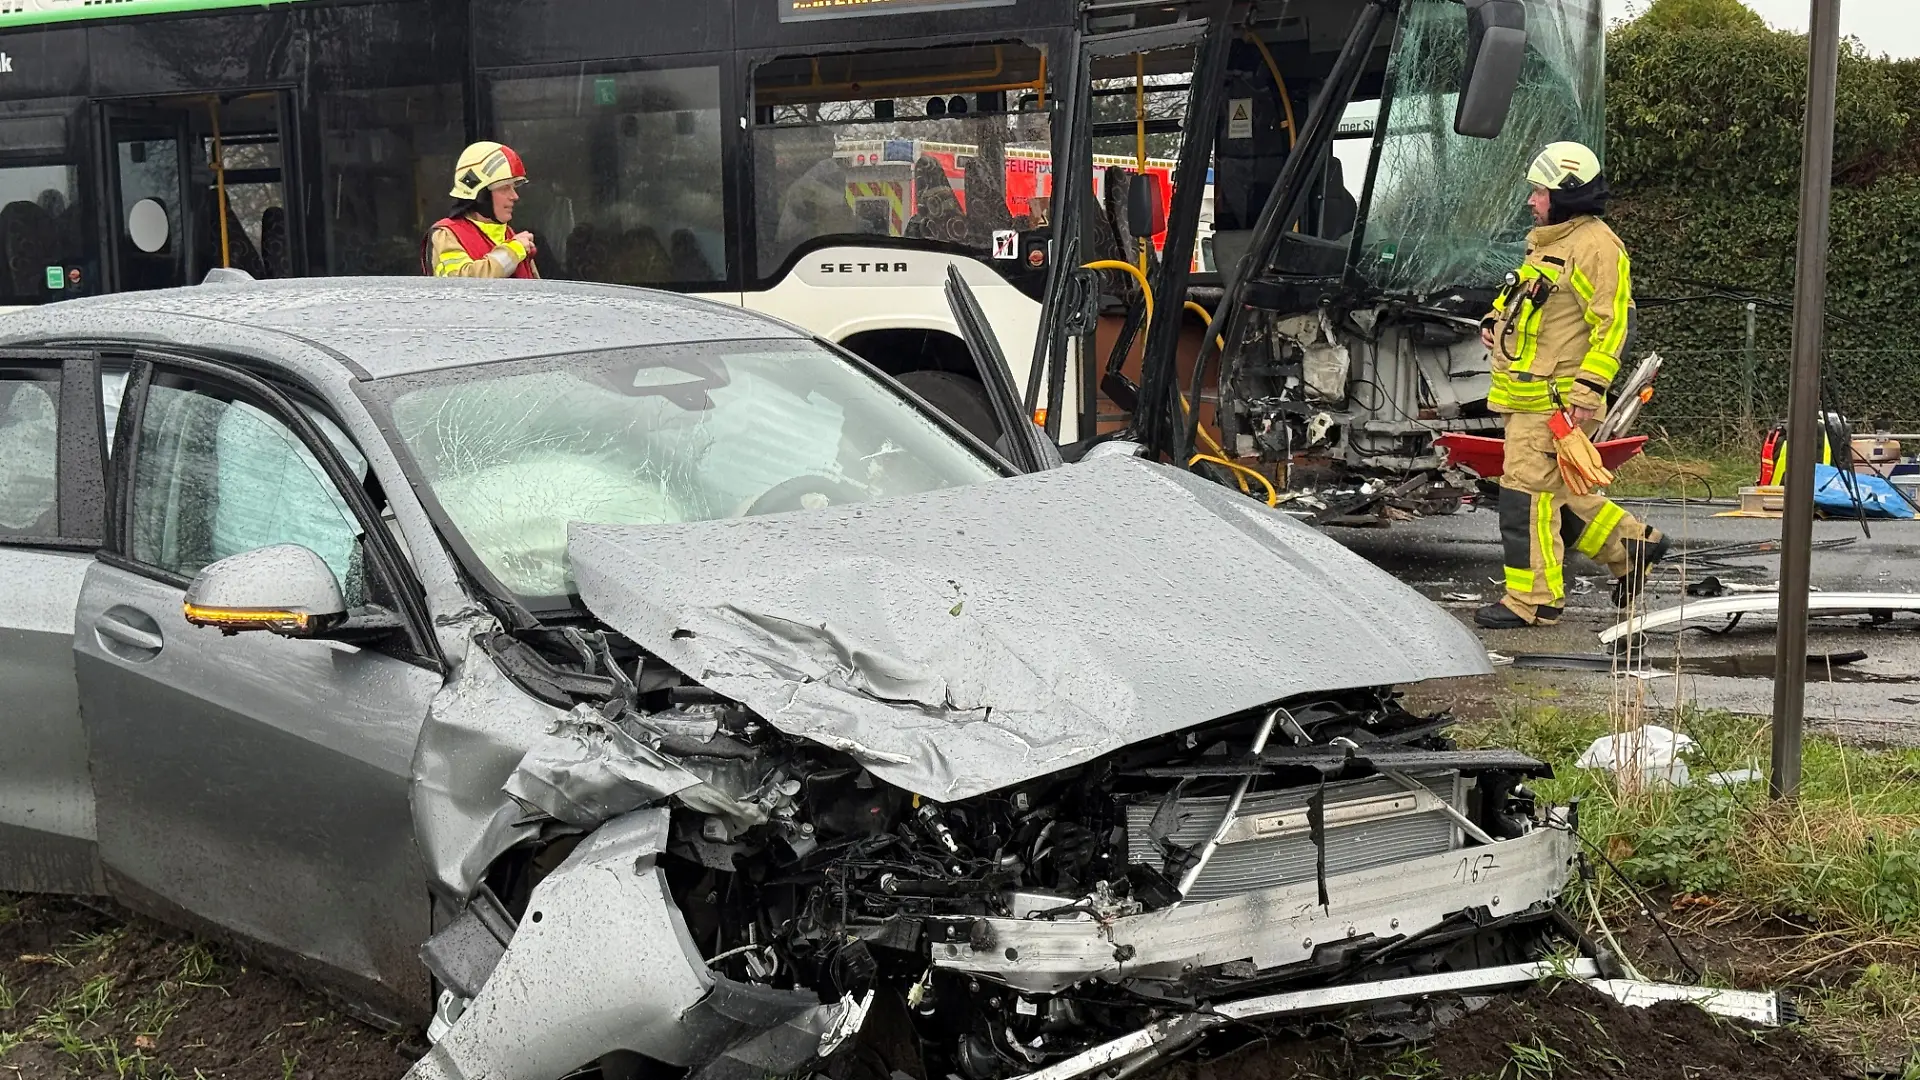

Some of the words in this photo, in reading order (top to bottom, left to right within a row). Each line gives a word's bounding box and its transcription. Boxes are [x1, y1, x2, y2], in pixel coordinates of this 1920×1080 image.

[1337, 121, 1361, 132] mer
[1363, 119, 1375, 131] St
[820, 262, 908, 273] SETRA
